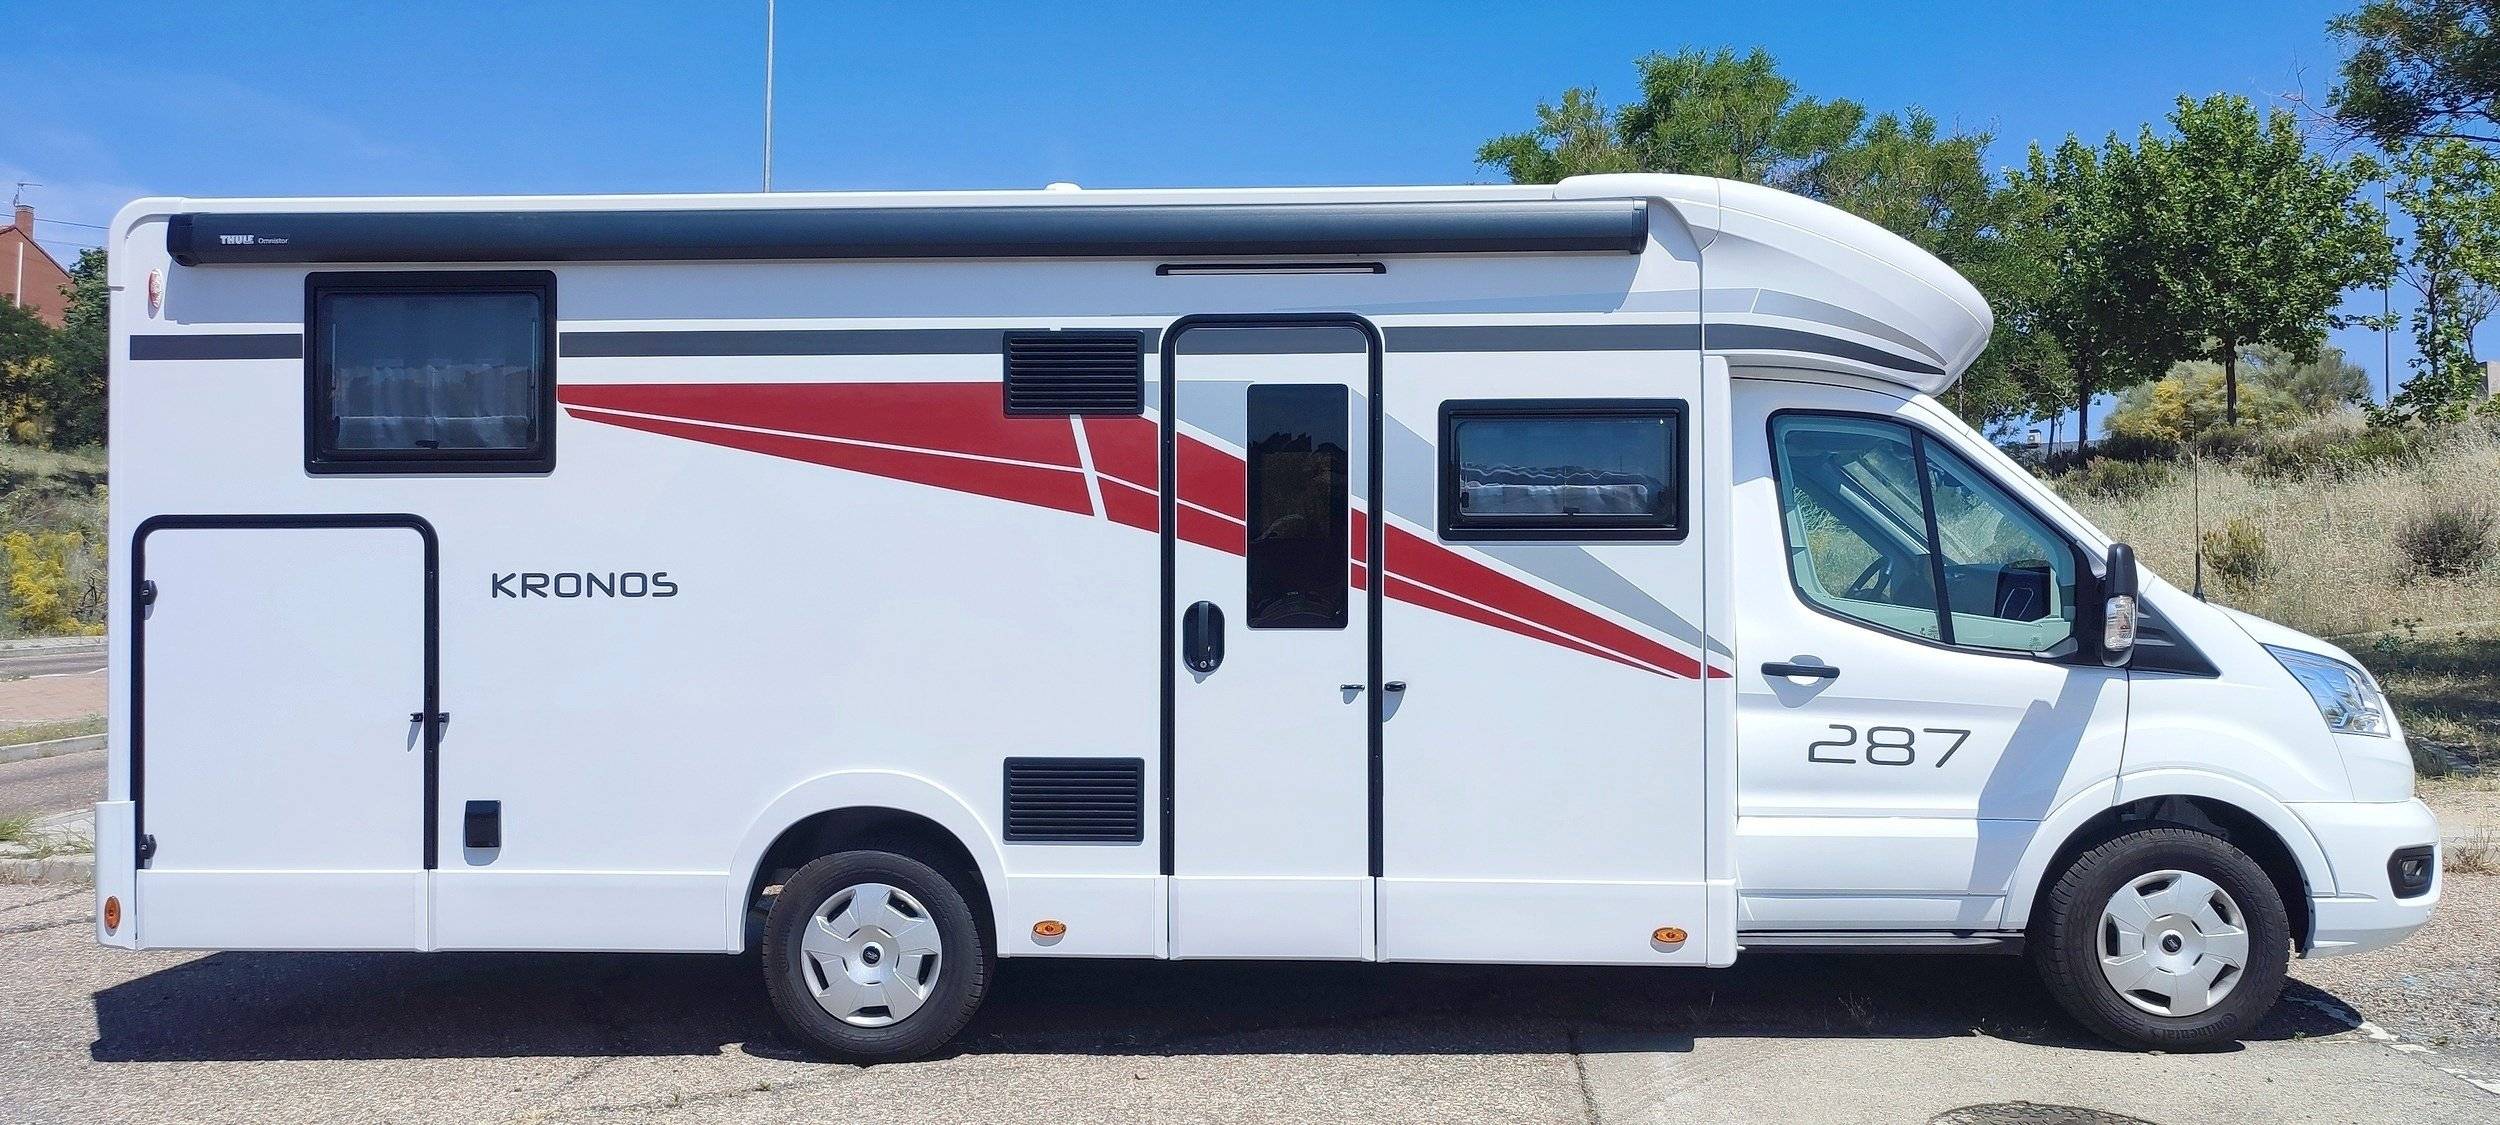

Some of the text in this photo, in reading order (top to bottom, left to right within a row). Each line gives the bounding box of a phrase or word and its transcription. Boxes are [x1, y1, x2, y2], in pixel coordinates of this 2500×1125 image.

[220, 235, 255, 245] THULE
[492, 572, 679, 599] KRONOS
[1808, 724, 1971, 768] 287
